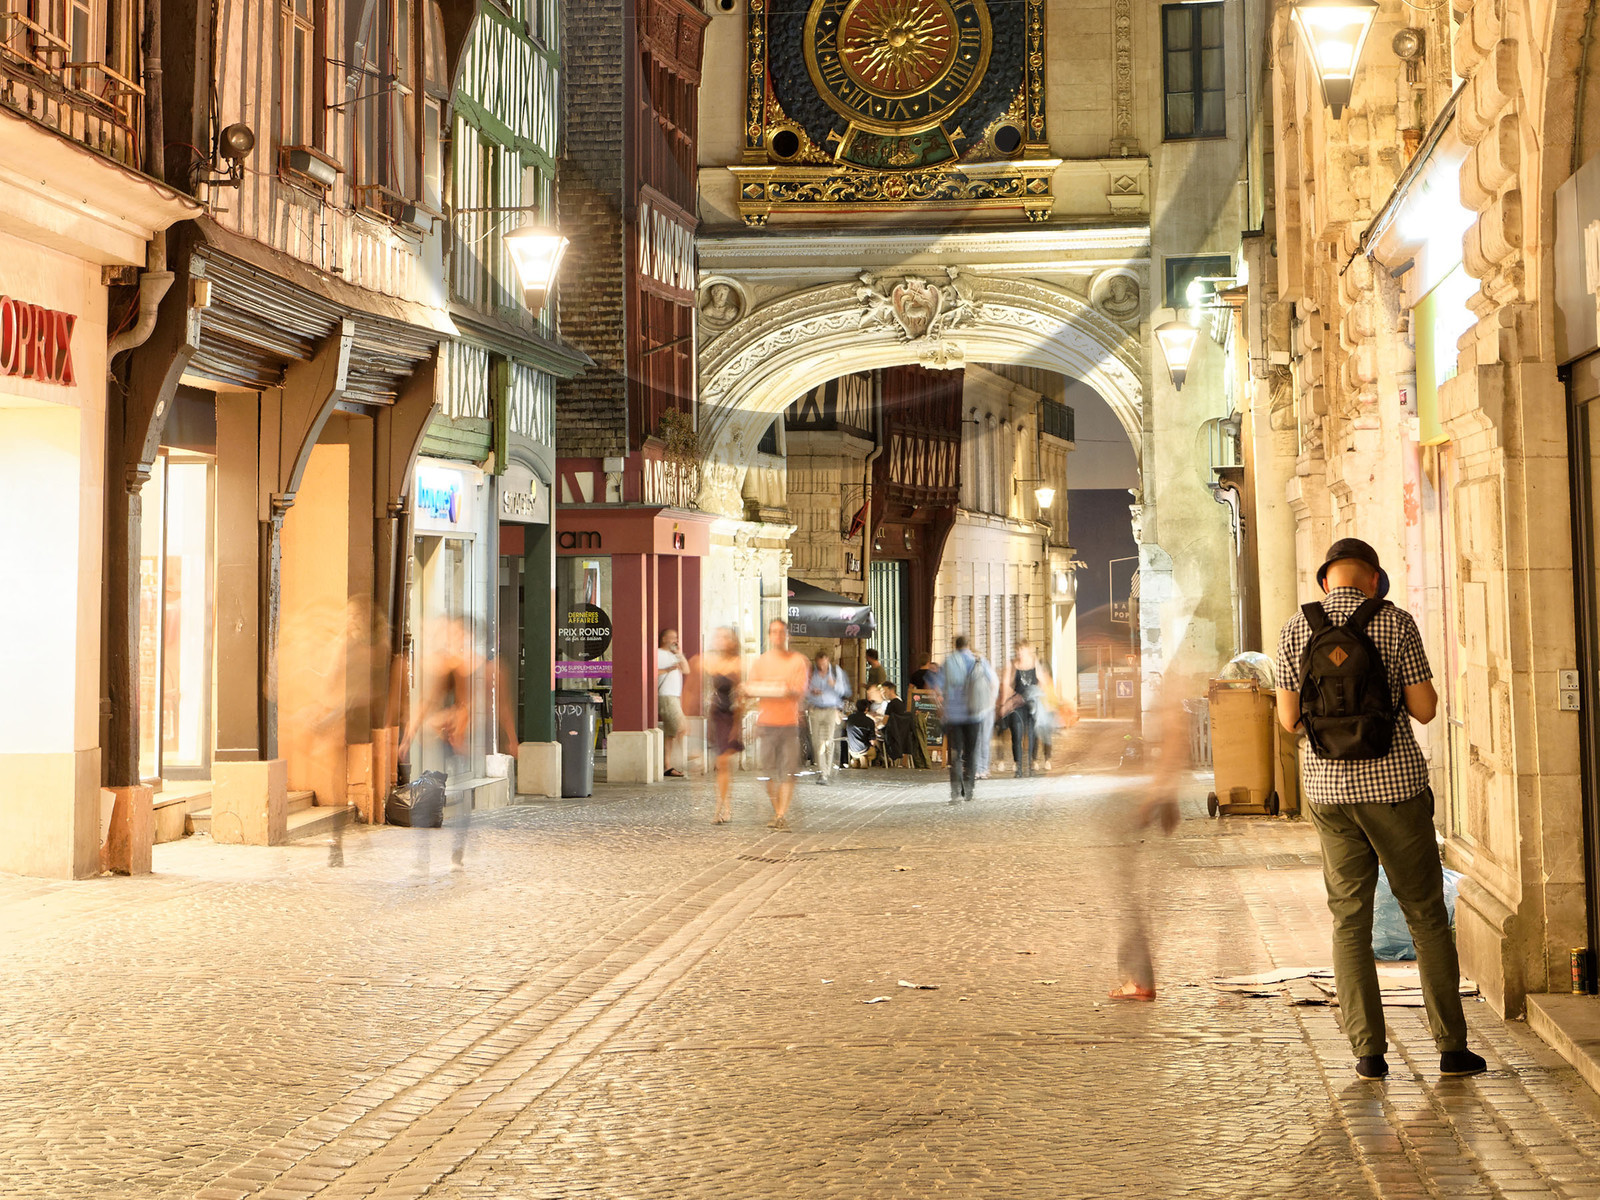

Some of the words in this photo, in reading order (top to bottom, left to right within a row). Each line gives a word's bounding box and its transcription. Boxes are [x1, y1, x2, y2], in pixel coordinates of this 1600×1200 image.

[960, 27, 981, 48] III
[555, 531, 602, 549] am
[558, 628, 577, 636] PRIX
[579, 628, 610, 636] RONDS
